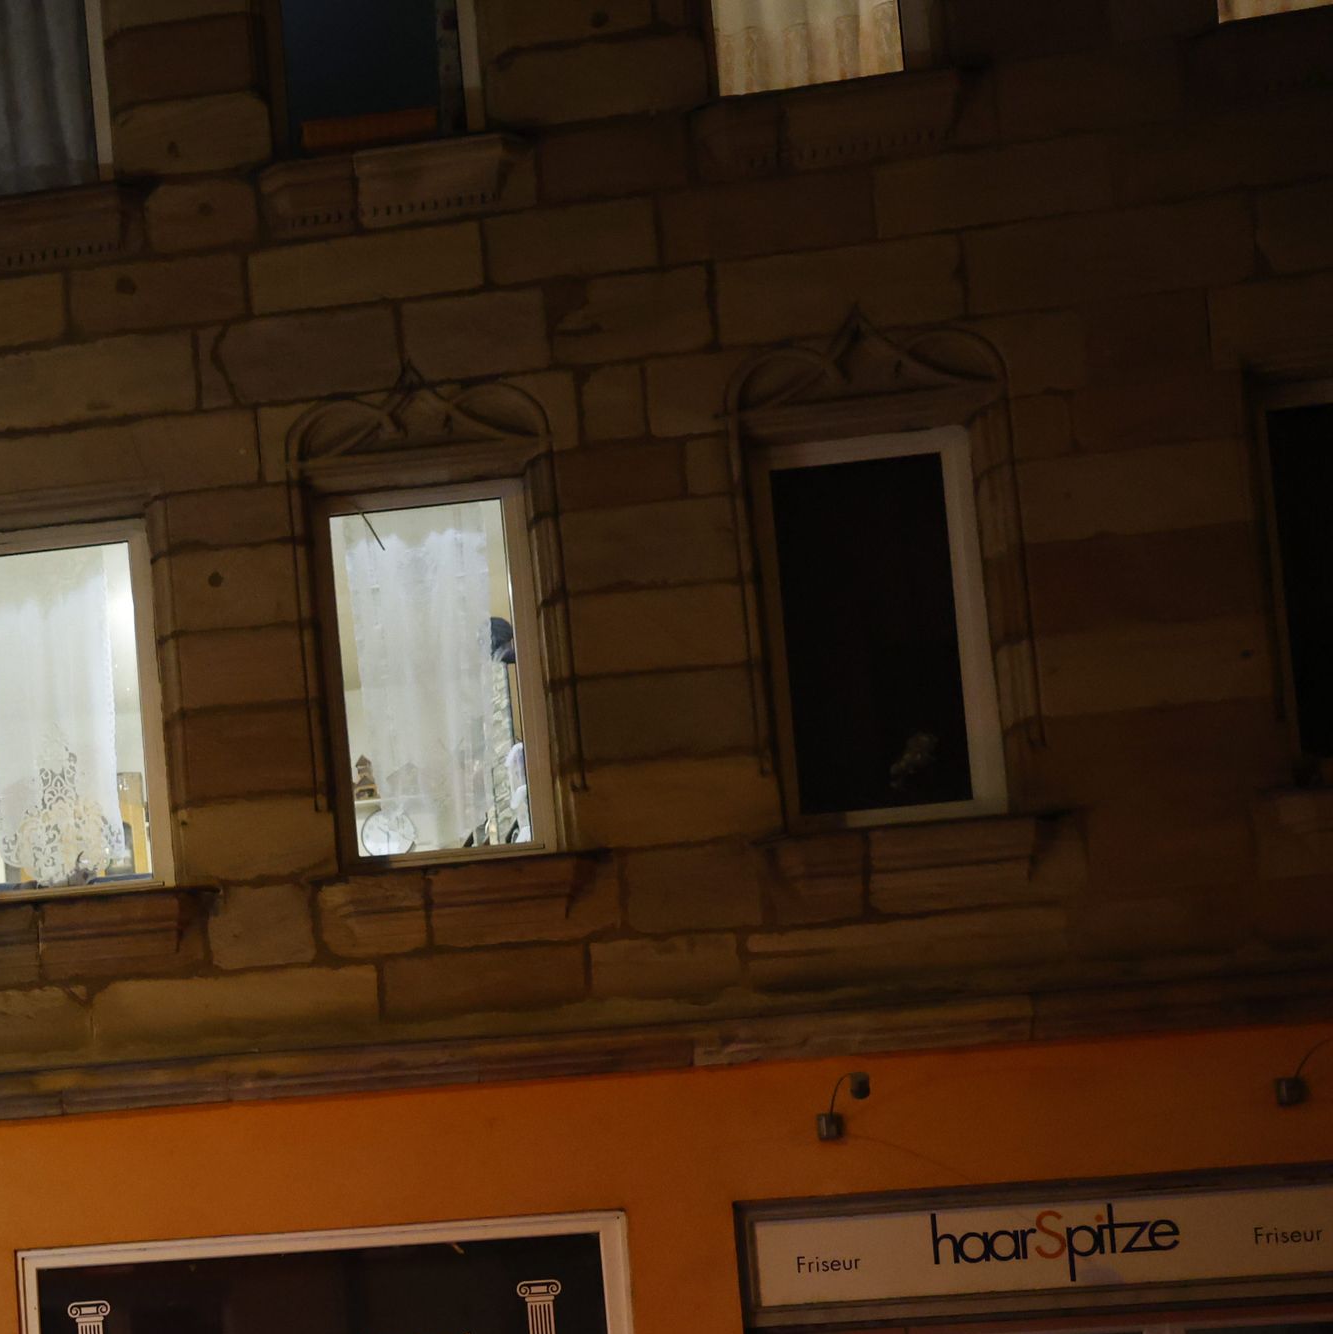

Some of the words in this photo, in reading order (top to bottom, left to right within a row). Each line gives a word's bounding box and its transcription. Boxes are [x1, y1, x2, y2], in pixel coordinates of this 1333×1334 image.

[931, 1203, 1180, 1282] haarSpitze
[1253, 1226, 1324, 1246] Friseur
[796, 1256, 861, 1274] Friseur
